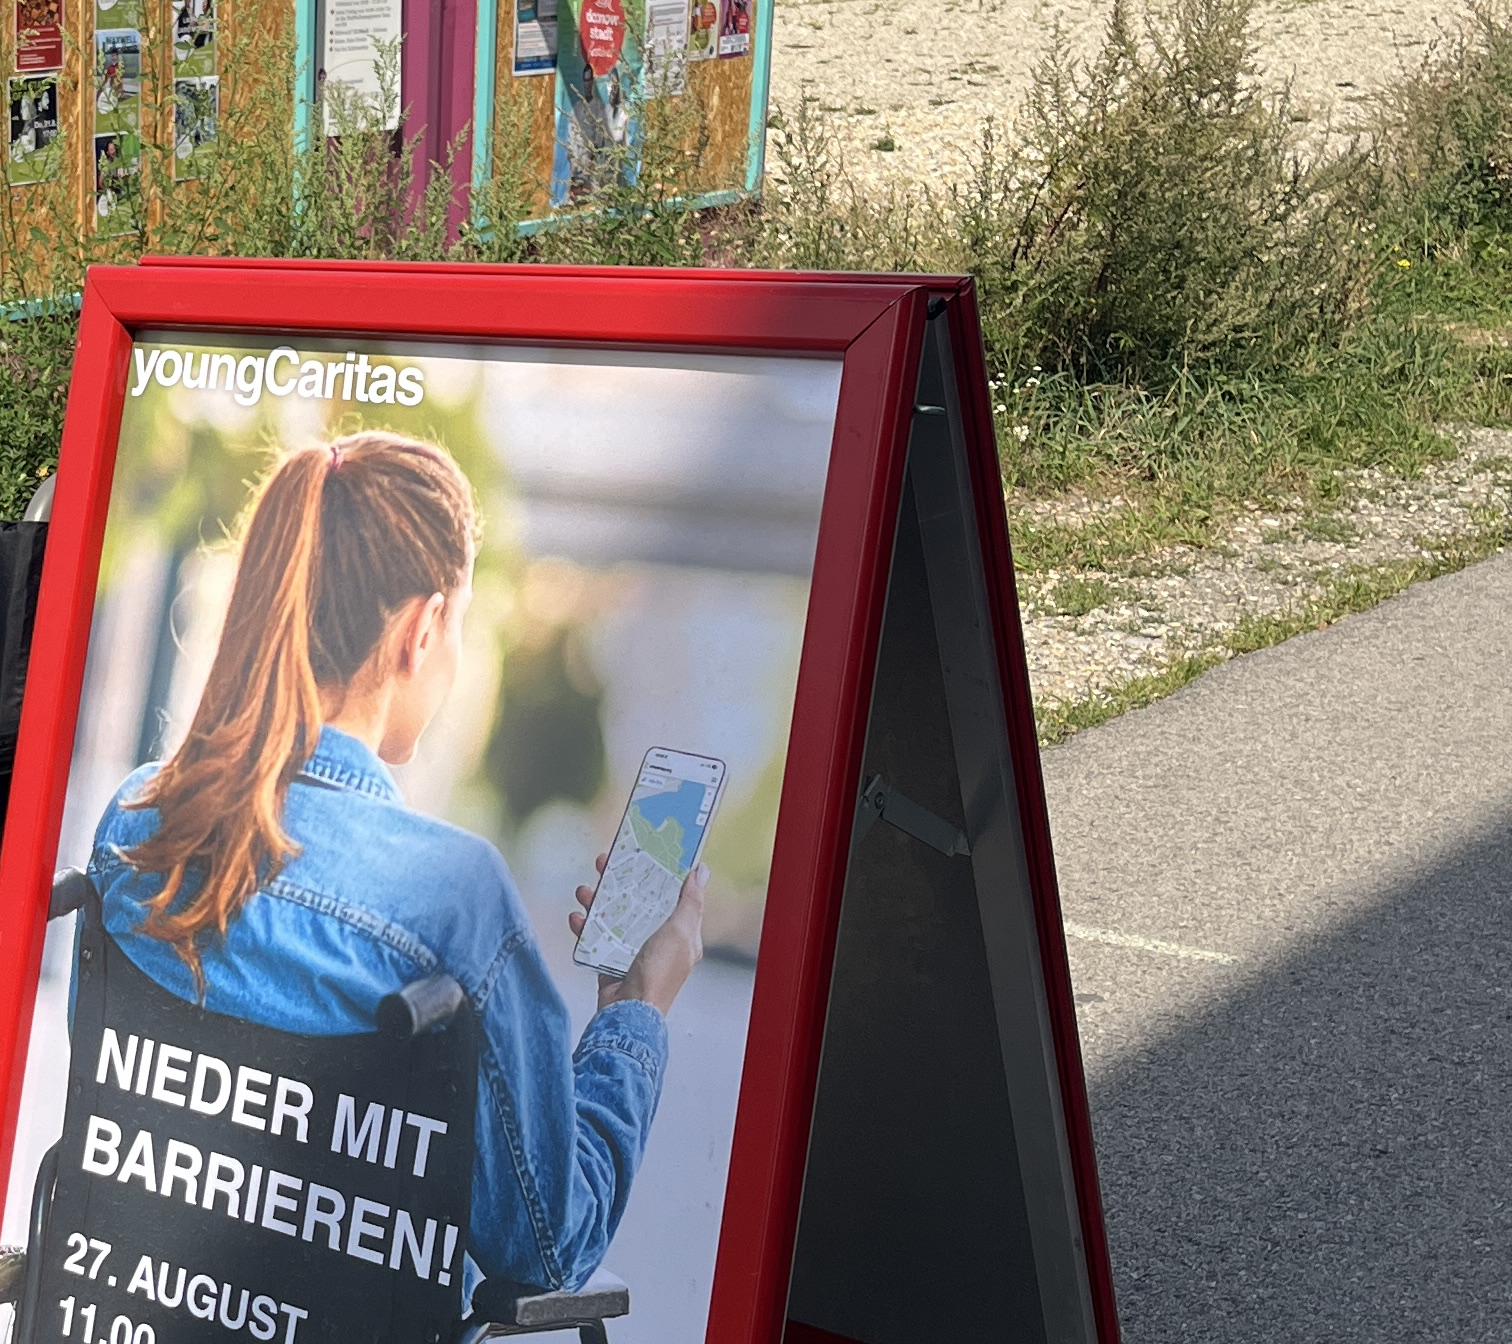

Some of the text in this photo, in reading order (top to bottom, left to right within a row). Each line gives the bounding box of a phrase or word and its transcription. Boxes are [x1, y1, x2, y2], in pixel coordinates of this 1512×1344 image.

[131, 345, 425, 407] youngCaritas
[96, 1027, 448, 1179] NIEDER MIT
[81, 1114, 460, 1288] BARRIEREN!
[62, 1231, 118, 1288] 27.
